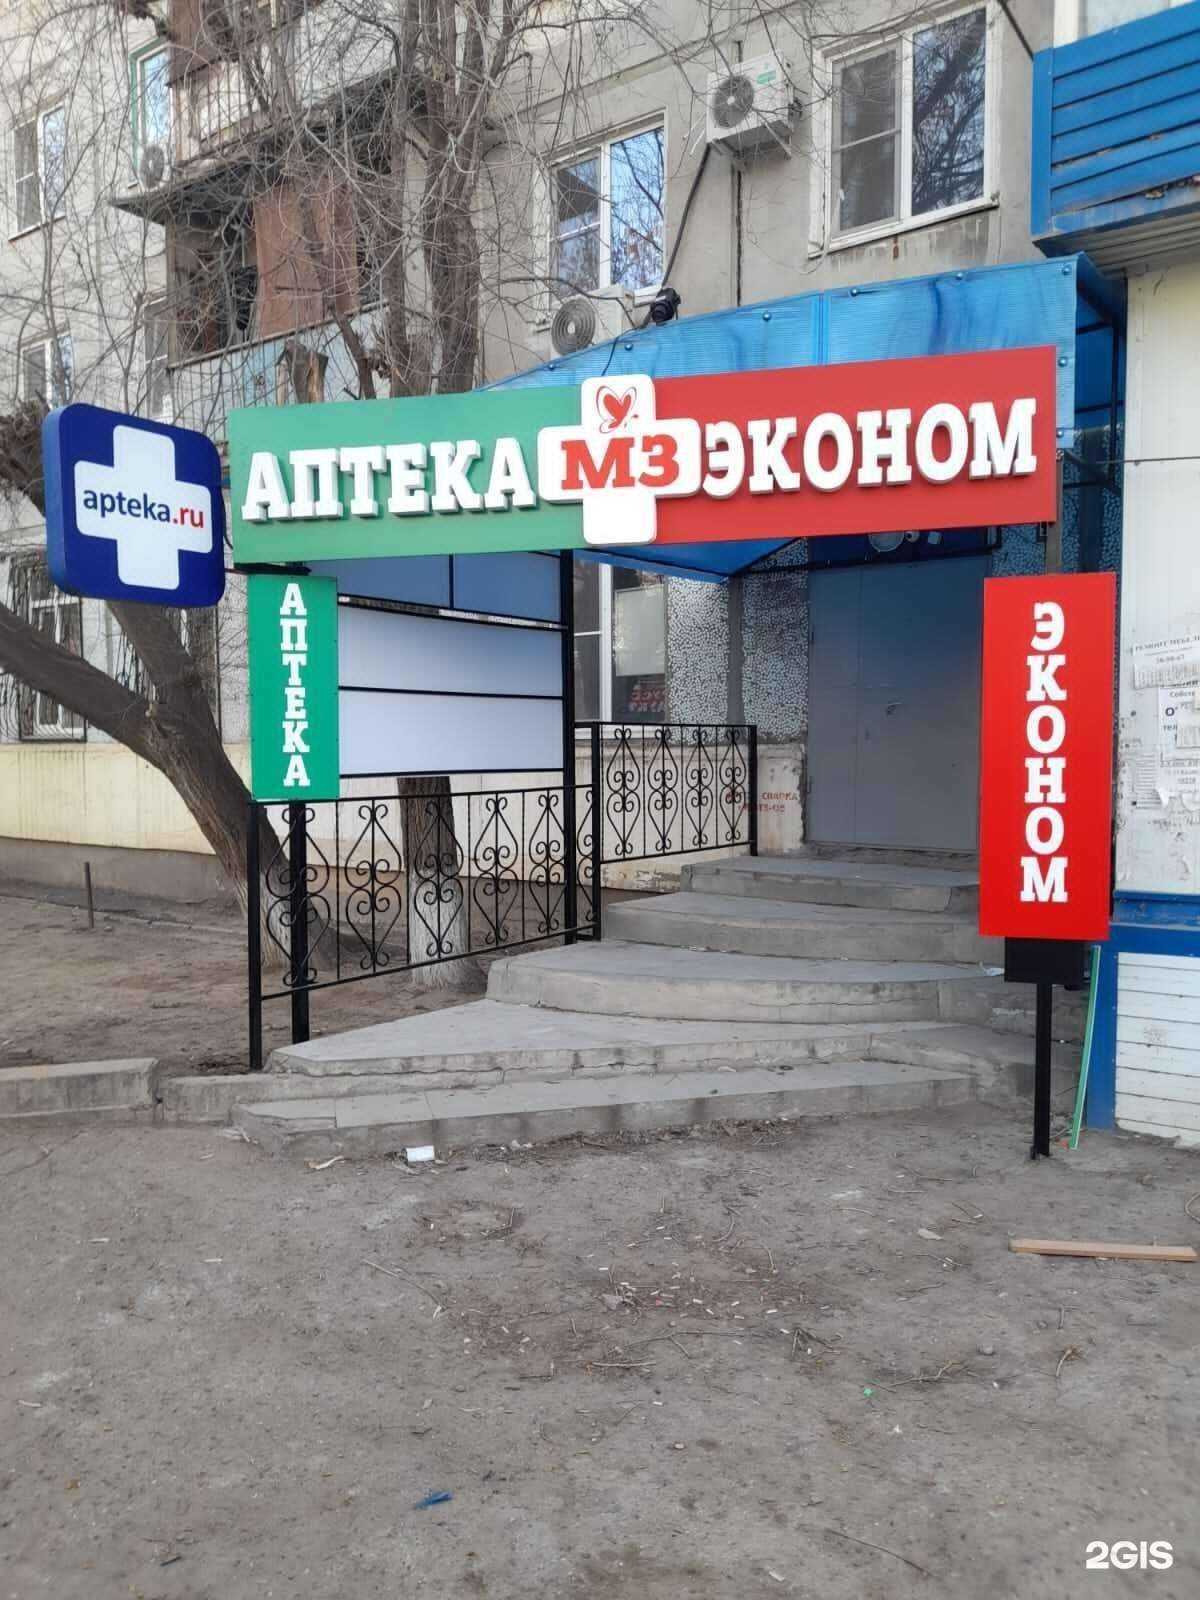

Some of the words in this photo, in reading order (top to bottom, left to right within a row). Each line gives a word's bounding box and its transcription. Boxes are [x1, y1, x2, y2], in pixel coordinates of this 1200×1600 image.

[83, 486, 205, 531] apteka.ru
[241, 437, 537, 521] АПТЕКА
[703, 398, 1038, 499] ЭКОНОМ
[280, 583, 311, 787] АПТЕКА
[1020, 601, 1069, 903] ЭКОНОМ
